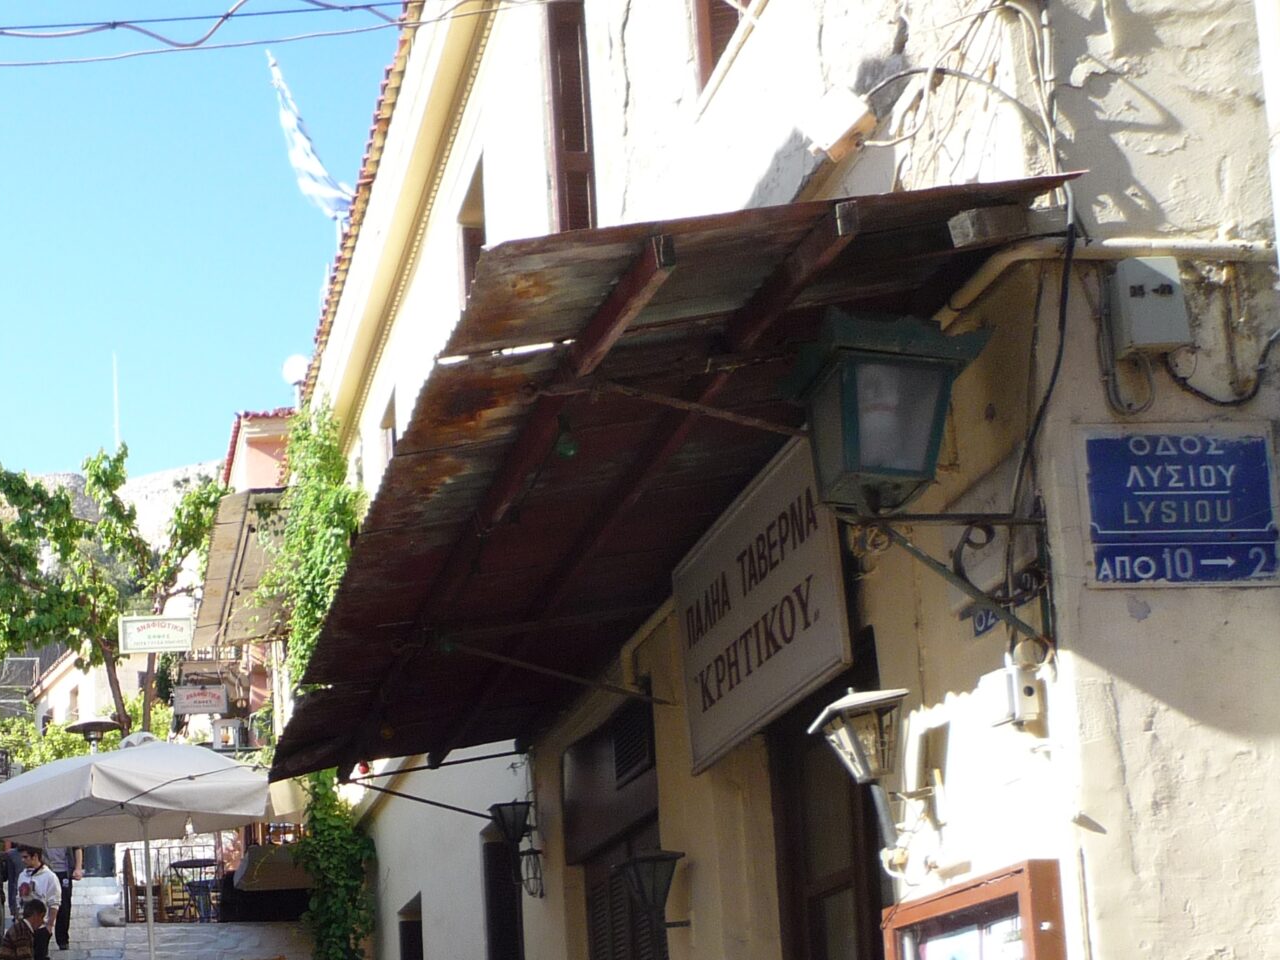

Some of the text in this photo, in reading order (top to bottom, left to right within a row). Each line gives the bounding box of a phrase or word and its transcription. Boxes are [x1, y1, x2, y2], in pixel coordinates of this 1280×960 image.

[1129, 435, 1224, 456] ΟΔΟΣ
[1126, 464, 1236, 488] ΛΥΣΙΟΥ
[1123, 499, 1233, 524] LYSIOU
[736, 486, 819, 598] ΤΑΒΕΡΝΑ
[1098, 546, 1272, 580] ΑΠΟ 10 2
